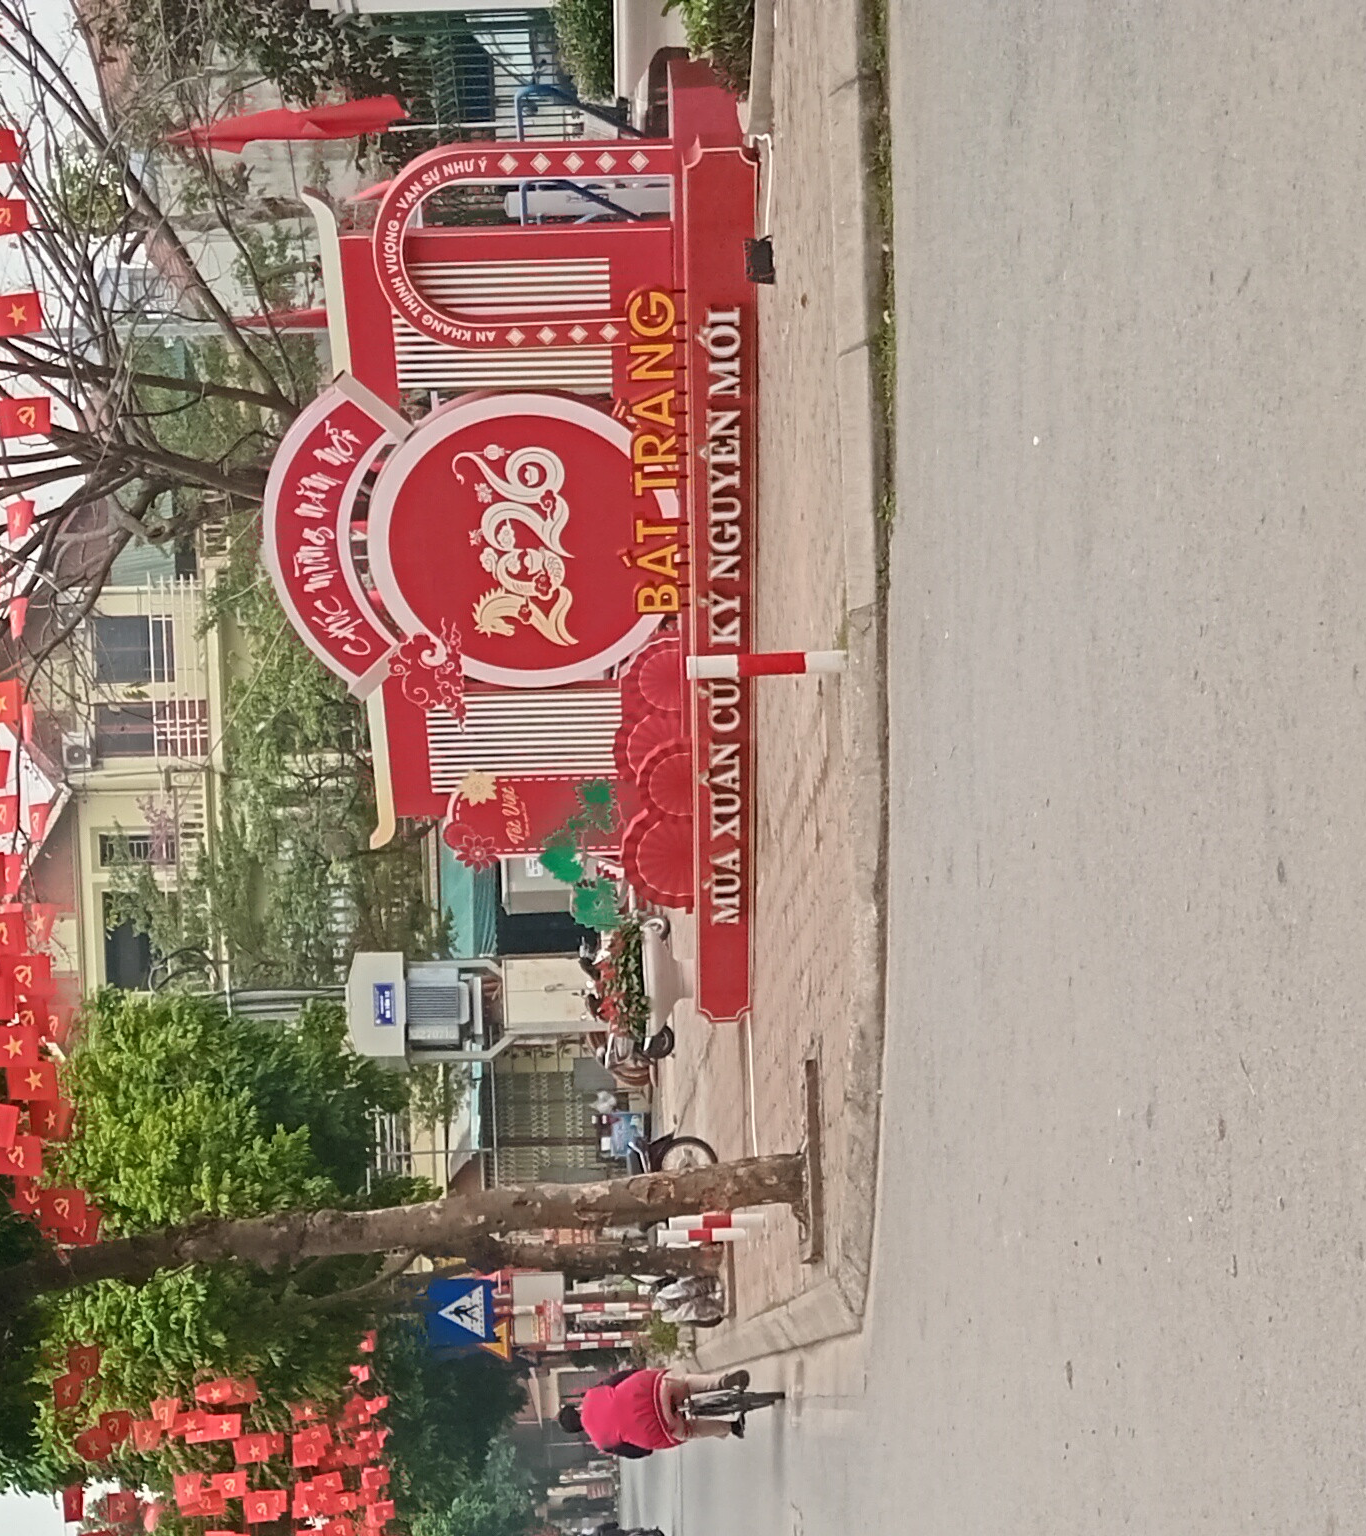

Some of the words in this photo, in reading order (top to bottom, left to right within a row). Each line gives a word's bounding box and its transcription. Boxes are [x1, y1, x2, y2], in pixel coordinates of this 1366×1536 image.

[421, 167, 443, 186] SỰ
[443, 158, 475, 176] NHƯ
[477, 156, 489, 172] Ý
[395, 181, 424, 210] VẠN
[382, 219, 401, 274] VƯỢNG
[390, 276, 423, 317] THỊNH
[422, 313, 474, 342] KHANG
[476, 330, 497, 342] AN
[694, 305, 742, 398] MỚI
[612, 288, 678, 496] TRÀNG
[697, 408, 742, 581] NGUYÊN
[452, 446, 580, 646] 2026
[616, 519, 680, 614] BÁT
[697, 676, 741, 733] CỦ
[501, 785, 521, 816] Việt
[698, 741, 741, 841] XUÂN
[505, 819, 525, 844] Tết
[701, 848, 742, 925] MÙA
